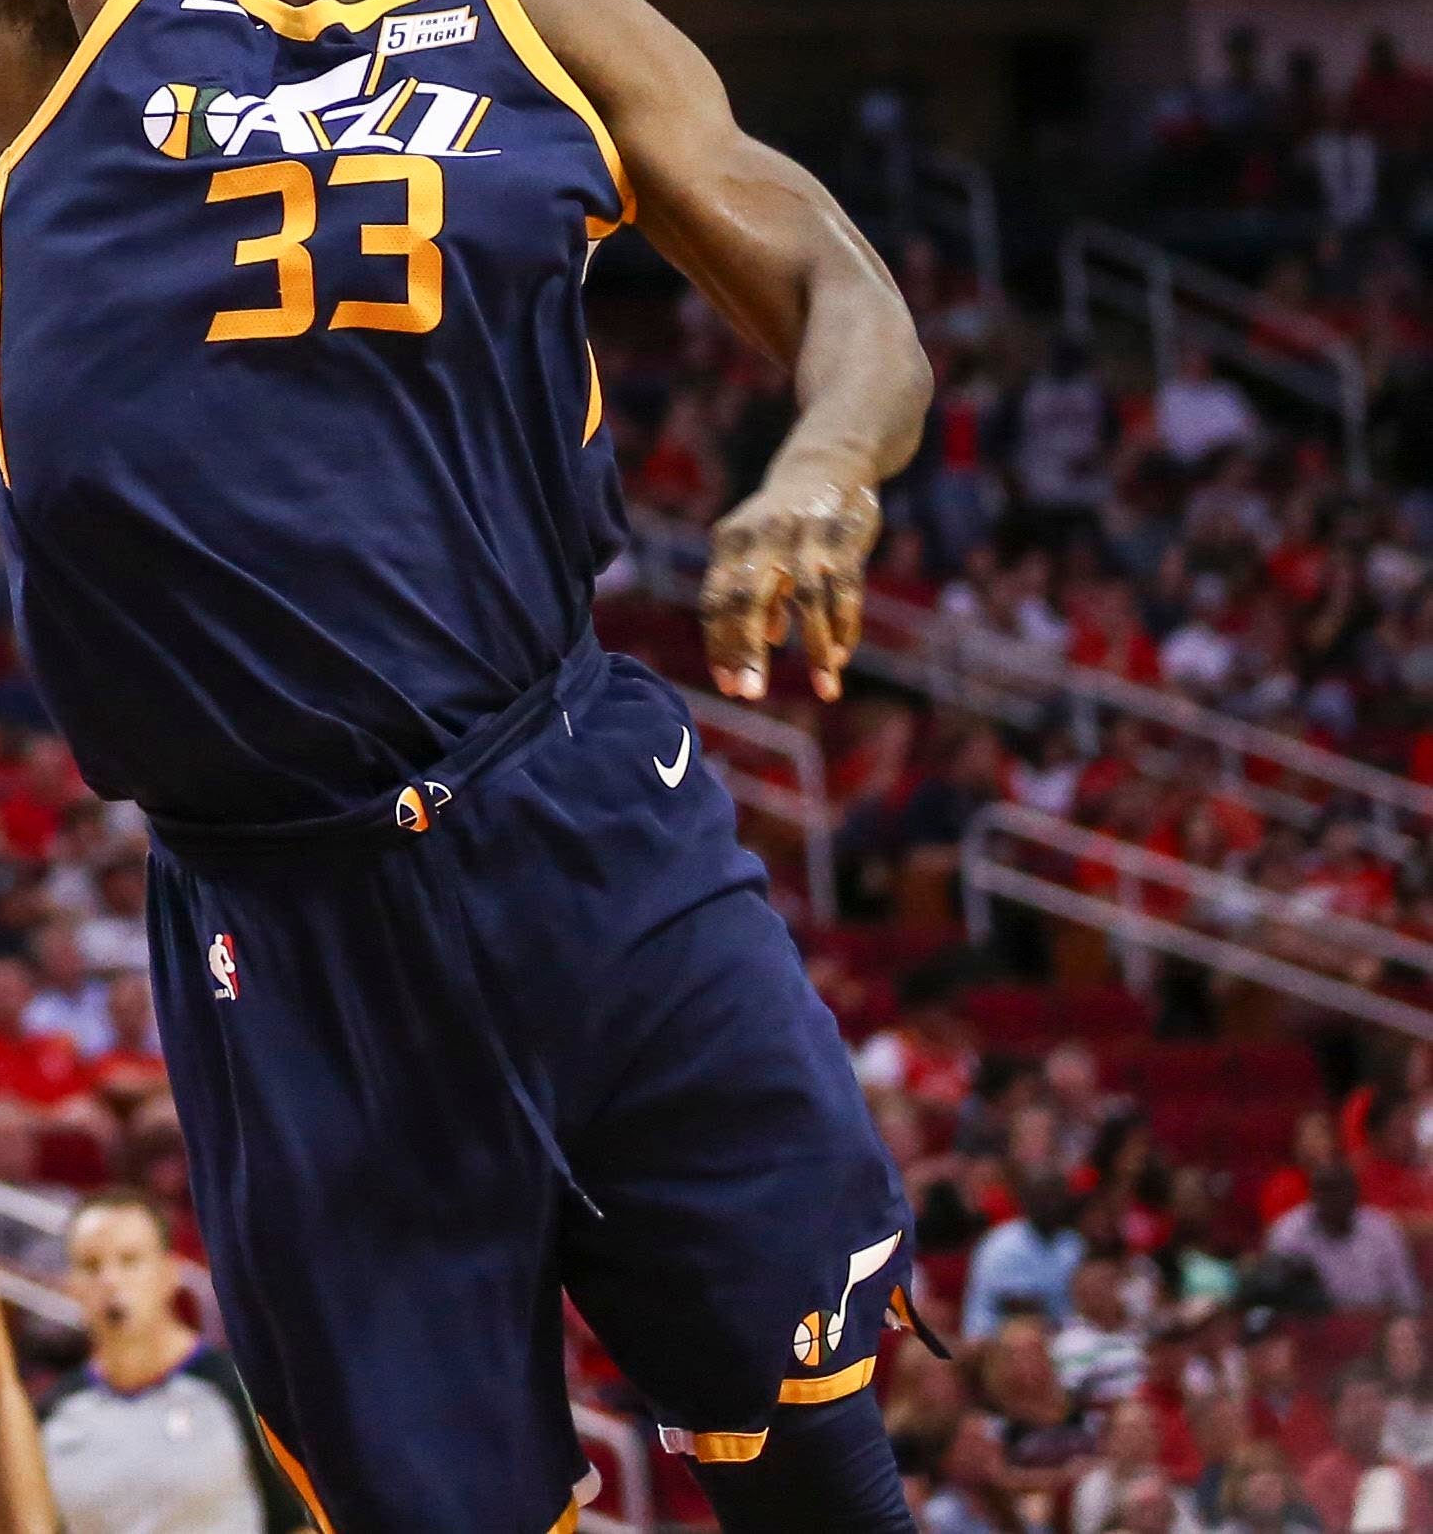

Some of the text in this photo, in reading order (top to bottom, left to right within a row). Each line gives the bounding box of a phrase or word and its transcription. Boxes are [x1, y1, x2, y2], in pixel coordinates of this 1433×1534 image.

[388, 14, 460, 49] 5 FOR THE
[416, 25, 468, 45] FIGHT
[141, 52, 503, 160] JAZZ
[204, 152, 444, 343] 33
